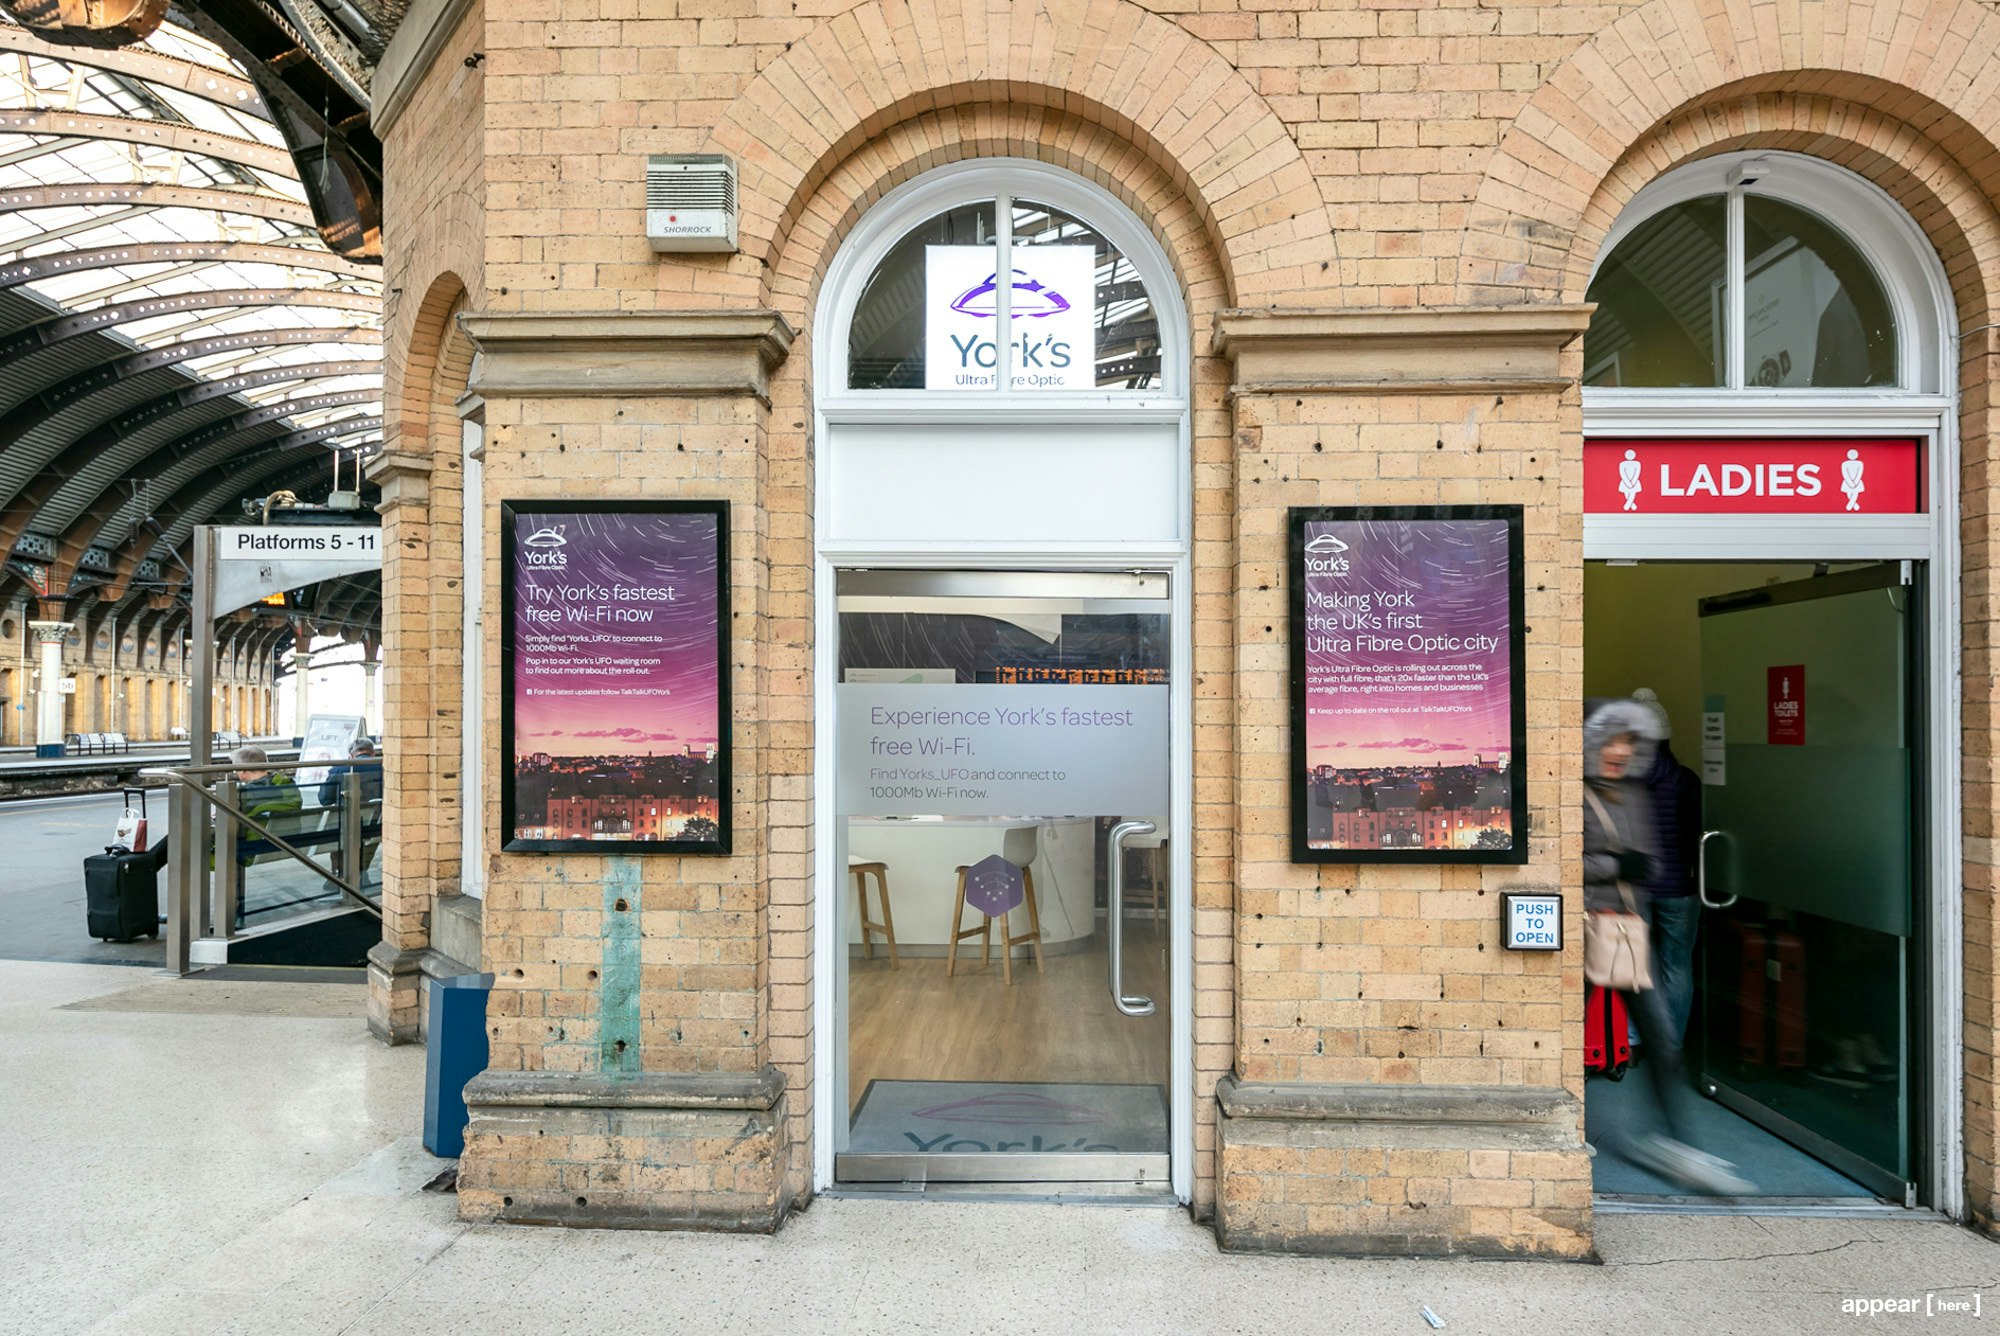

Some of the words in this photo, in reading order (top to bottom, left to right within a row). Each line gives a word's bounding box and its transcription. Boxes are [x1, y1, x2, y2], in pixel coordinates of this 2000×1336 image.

[663, 226, 712, 234] SHORROCK
[955, 374, 988, 386] Ultra
[991, 374, 1025, 386] Fre
[1028, 373, 1065, 387] Optic
[1660, 463, 1822, 497] LADIES
[238, 534, 325, 550] Platforms
[330, 535, 341, 550] 5
[358, 535, 375, 550] 11
[524, 550, 567, 564] York's
[1304, 557, 1350, 571] York's
[525, 584, 553, 604] Try
[557, 584, 609, 601] York's
[613, 584, 675, 601] fastest
[1306, 591, 1371, 612] Making
[1374, 590, 1415, 608] York
[525, 605, 561, 622] free
[566, 605, 611, 622] Wi-Fi
[615, 608, 654, 622] now
[1306, 614, 1338, 629] the
[1342, 613, 1382, 629] UK's
[1386, 613, 1423, 629] first
[525, 634, 550, 644] Simply
[551, 634, 566, 642] find
[1307, 636, 1352, 652] Ultra
[1356, 635, 1403, 651] Fibre
[1408, 634, 1460, 654] Optic
[1463, 633, 1499, 654] city
[525, 644, 557, 652] 1000Mb
[525, 657, 541, 666] Pop
[612, 657, 640, 666] waiting
[585, 667, 607, 675] about
[608, 667, 622, 675] the
[622, 667, 635, 675] roll
[1308, 665, 1331, 673] York's
[1331, 665, 1350, 673] Ultra
[1372, 664, 1394, 674] Optic
[1395, 664, 1402, 672] is
[1403, 664, 1426, 673] rolling
[1469, 663, 1483, 671] the
[1308, 676, 1322, 684] city
[1375, 674, 1397, 682] that's
[1360, 685, 1379, 694] right
[1773, 702, 1799, 710] LADIES
[870, 706, 991, 729] Experience
[995, 706, 1057, 726] York's
[1061, 706, 1134, 726] fastest
[870, 736, 913, 756] free
[918, 736, 976, 756] Wi-Fi.
[870, 768, 897, 780] Find
[900, 768, 969, 782] Yorks_UFO
[970, 768, 995, 781] and
[997, 770, 1050, 781] connect
[1052, 770, 1066, 781] to
[870, 786, 923, 799] 1000Mb
[926, 786, 958, 799] Wi-Fi
[959, 788, 990, 799] now.
[1516, 904, 1554, 915] PUSH
[1525, 918, 1545, 929] TO
[1516, 932, 1554, 943] OPEN
